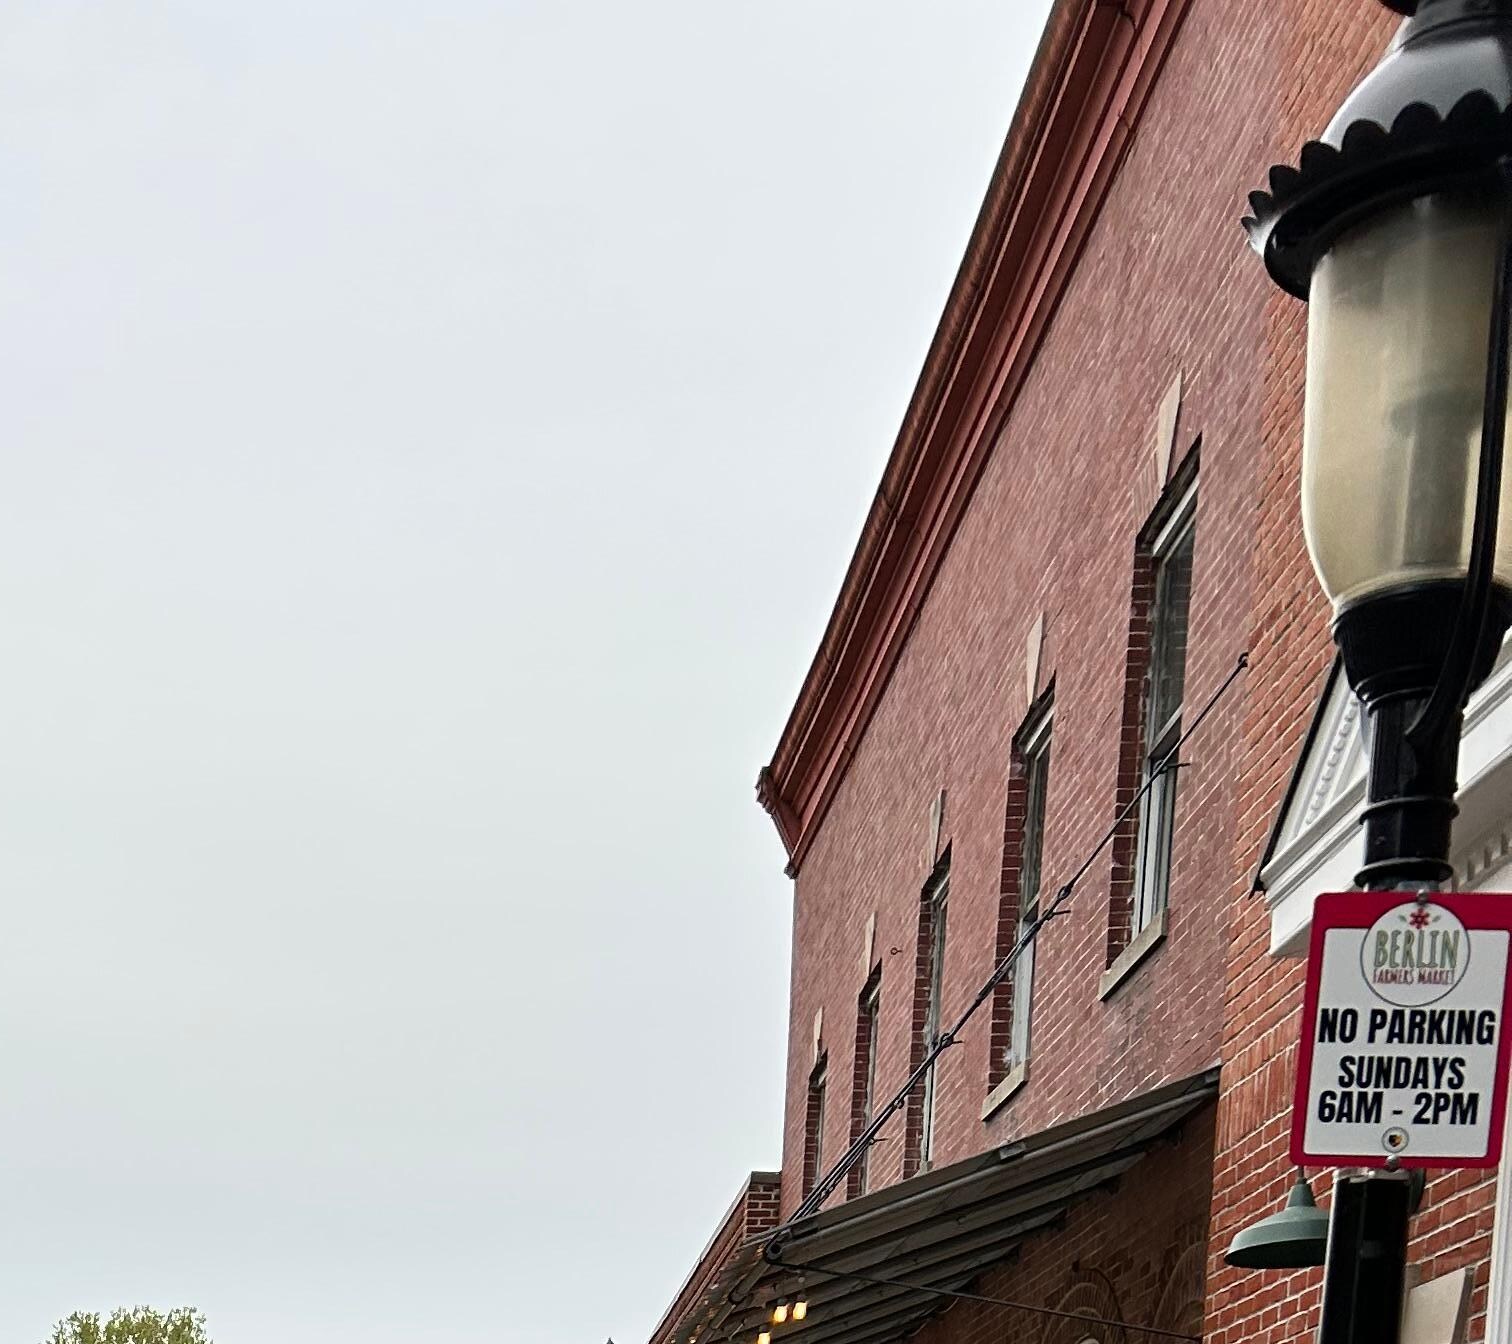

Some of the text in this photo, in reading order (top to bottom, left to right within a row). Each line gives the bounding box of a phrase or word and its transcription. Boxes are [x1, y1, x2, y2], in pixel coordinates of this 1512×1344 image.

[1373, 929, 1460, 969] BERLIN
[1372, 968, 1456, 985] FARMERS MARKET
[1318, 1008, 1496, 1046] NO PARKING
[1338, 1055, 1466, 1090] SUNDAYS
[1318, 1090, 1384, 1124] 6AM
[1412, 1092, 1480, 1125] 2PM
